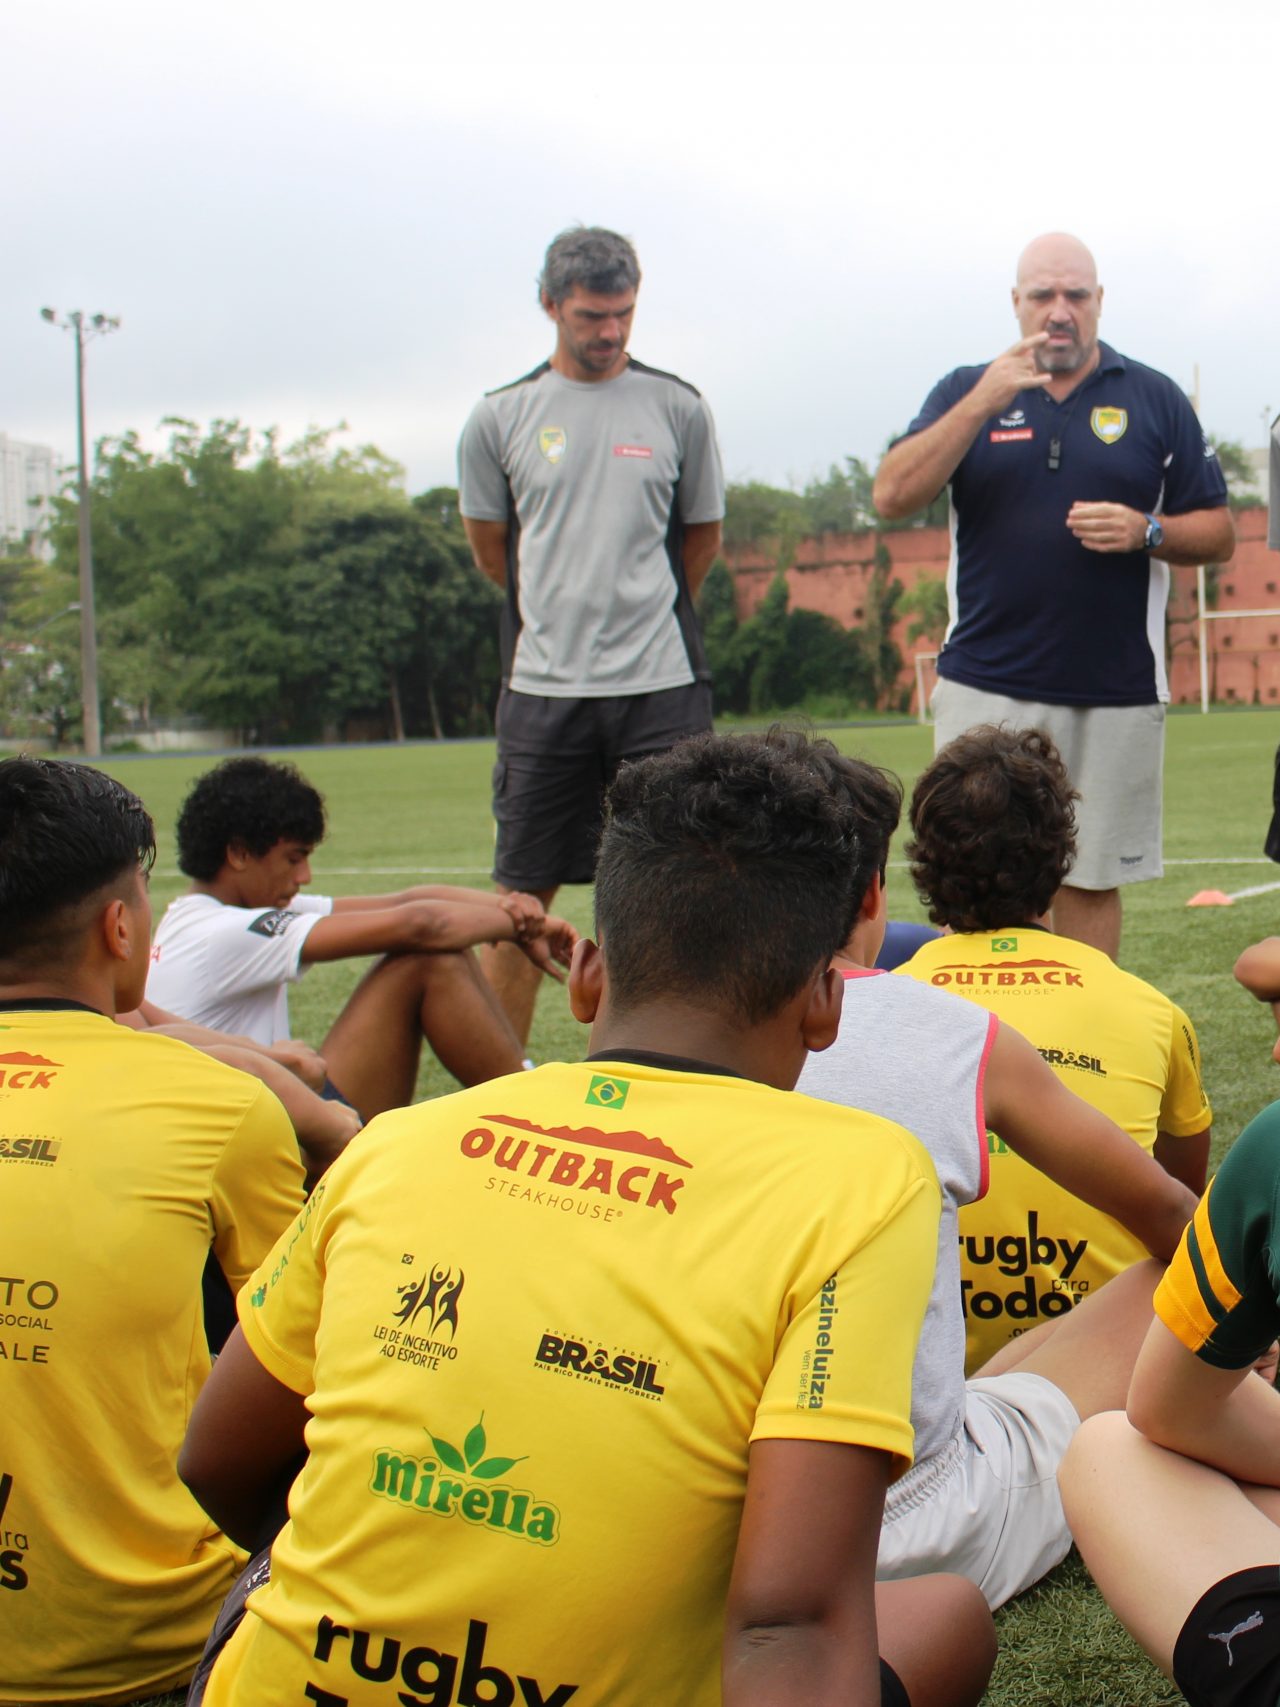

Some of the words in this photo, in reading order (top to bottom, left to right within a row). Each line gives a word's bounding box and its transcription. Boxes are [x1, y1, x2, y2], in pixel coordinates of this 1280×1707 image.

[931, 971, 1084, 988] OUTBACK
[460, 1128, 685, 1215] OUTBACK
[958, 1210, 1089, 1279] ugby
[960, 1276, 1084, 1320] Todo
[373, 1324, 388, 1342] LEI
[388, 1328, 402, 1345] DE
[402, 1332, 458, 1361] INCENTIVO
[379, 1344, 396, 1360] AO
[397, 1348, 440, 1371] ESPORTE
[536, 1334, 665, 1395] BRASIL
[808, 1271, 838, 1409] azineluiza
[554, 1367, 573, 1378] RICO
[604, 1380, 621, 1391] SEM
[623, 1386, 662, 1402] POBREZA
[372, 1451, 556, 1542] mirella
